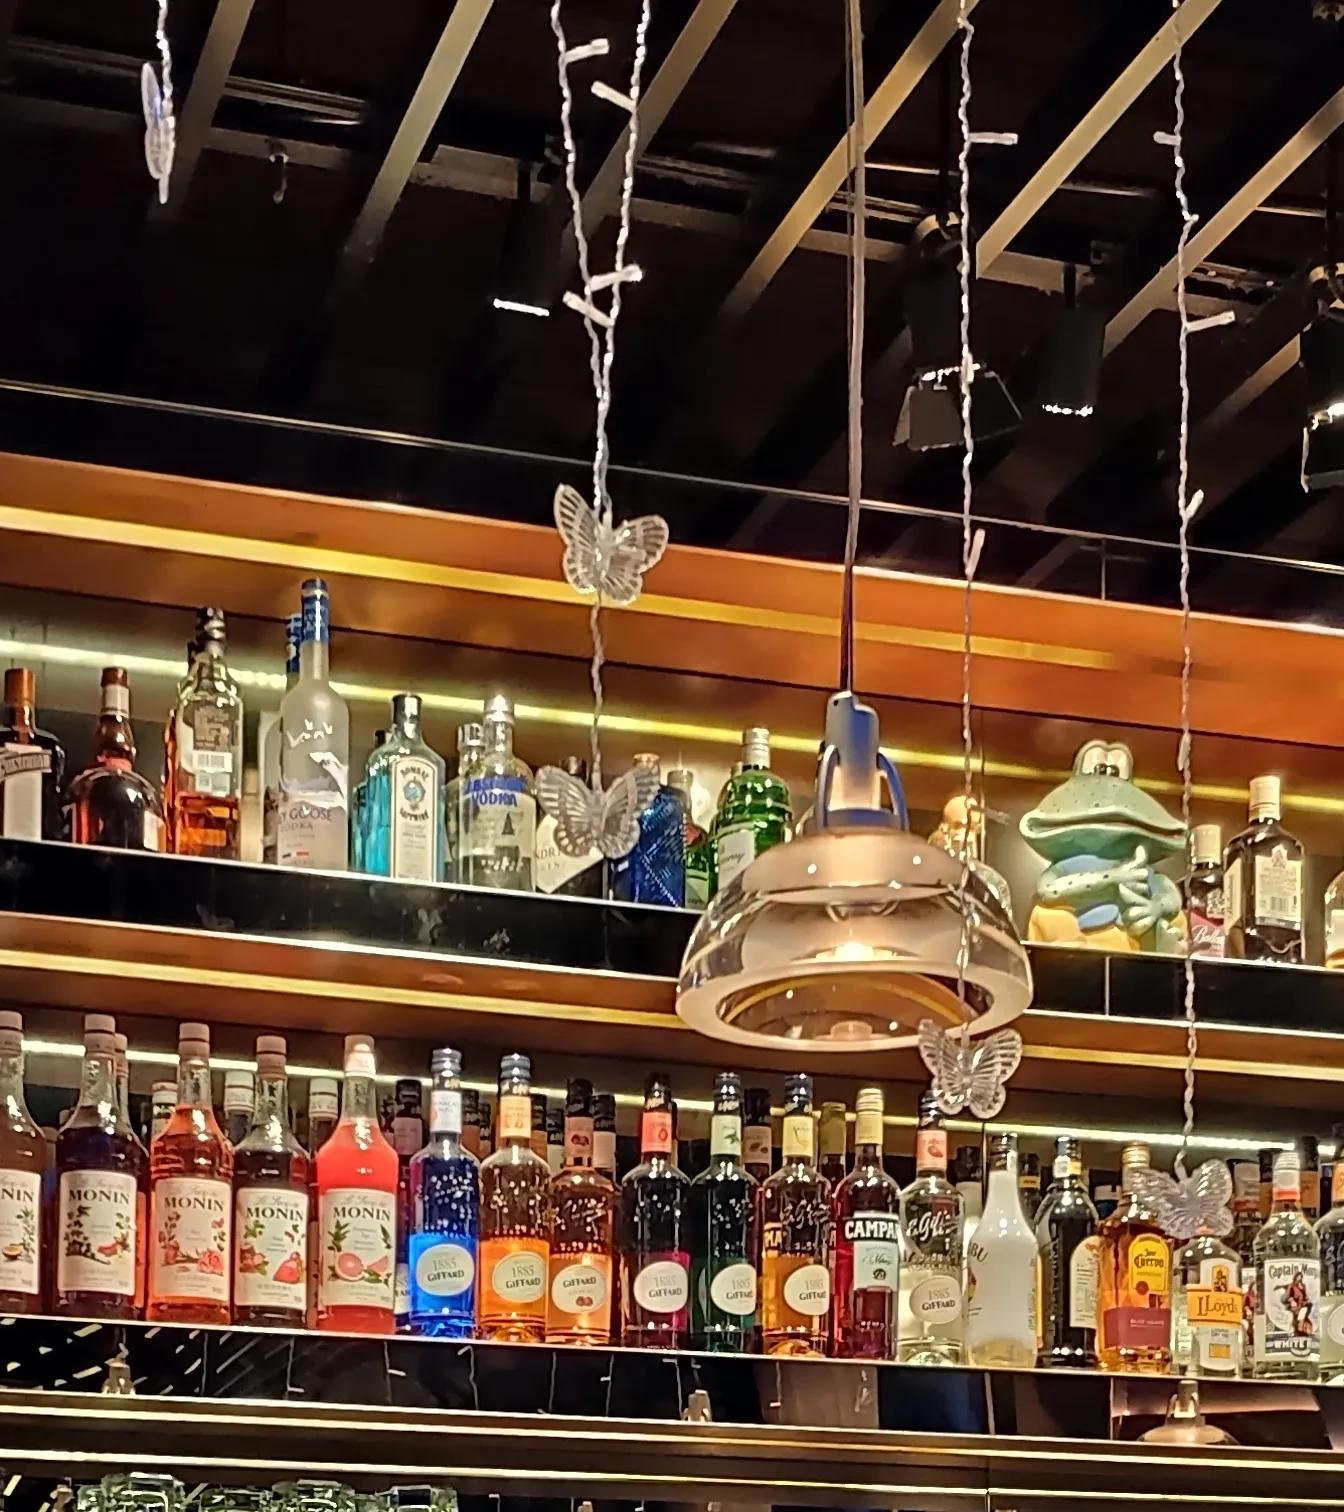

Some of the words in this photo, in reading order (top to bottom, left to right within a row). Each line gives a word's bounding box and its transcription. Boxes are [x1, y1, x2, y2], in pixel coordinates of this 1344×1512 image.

[69, 1188, 130, 1205] MONIN
[164, 1196, 225, 1213] MONIN
[246, 1206, 304, 1222] MONIN
[333, 1206, 391, 1221] MONIN
[1134, 1254, 1164, 1269] Cuervo
[1269, 1263, 1298, 1278] Captain
